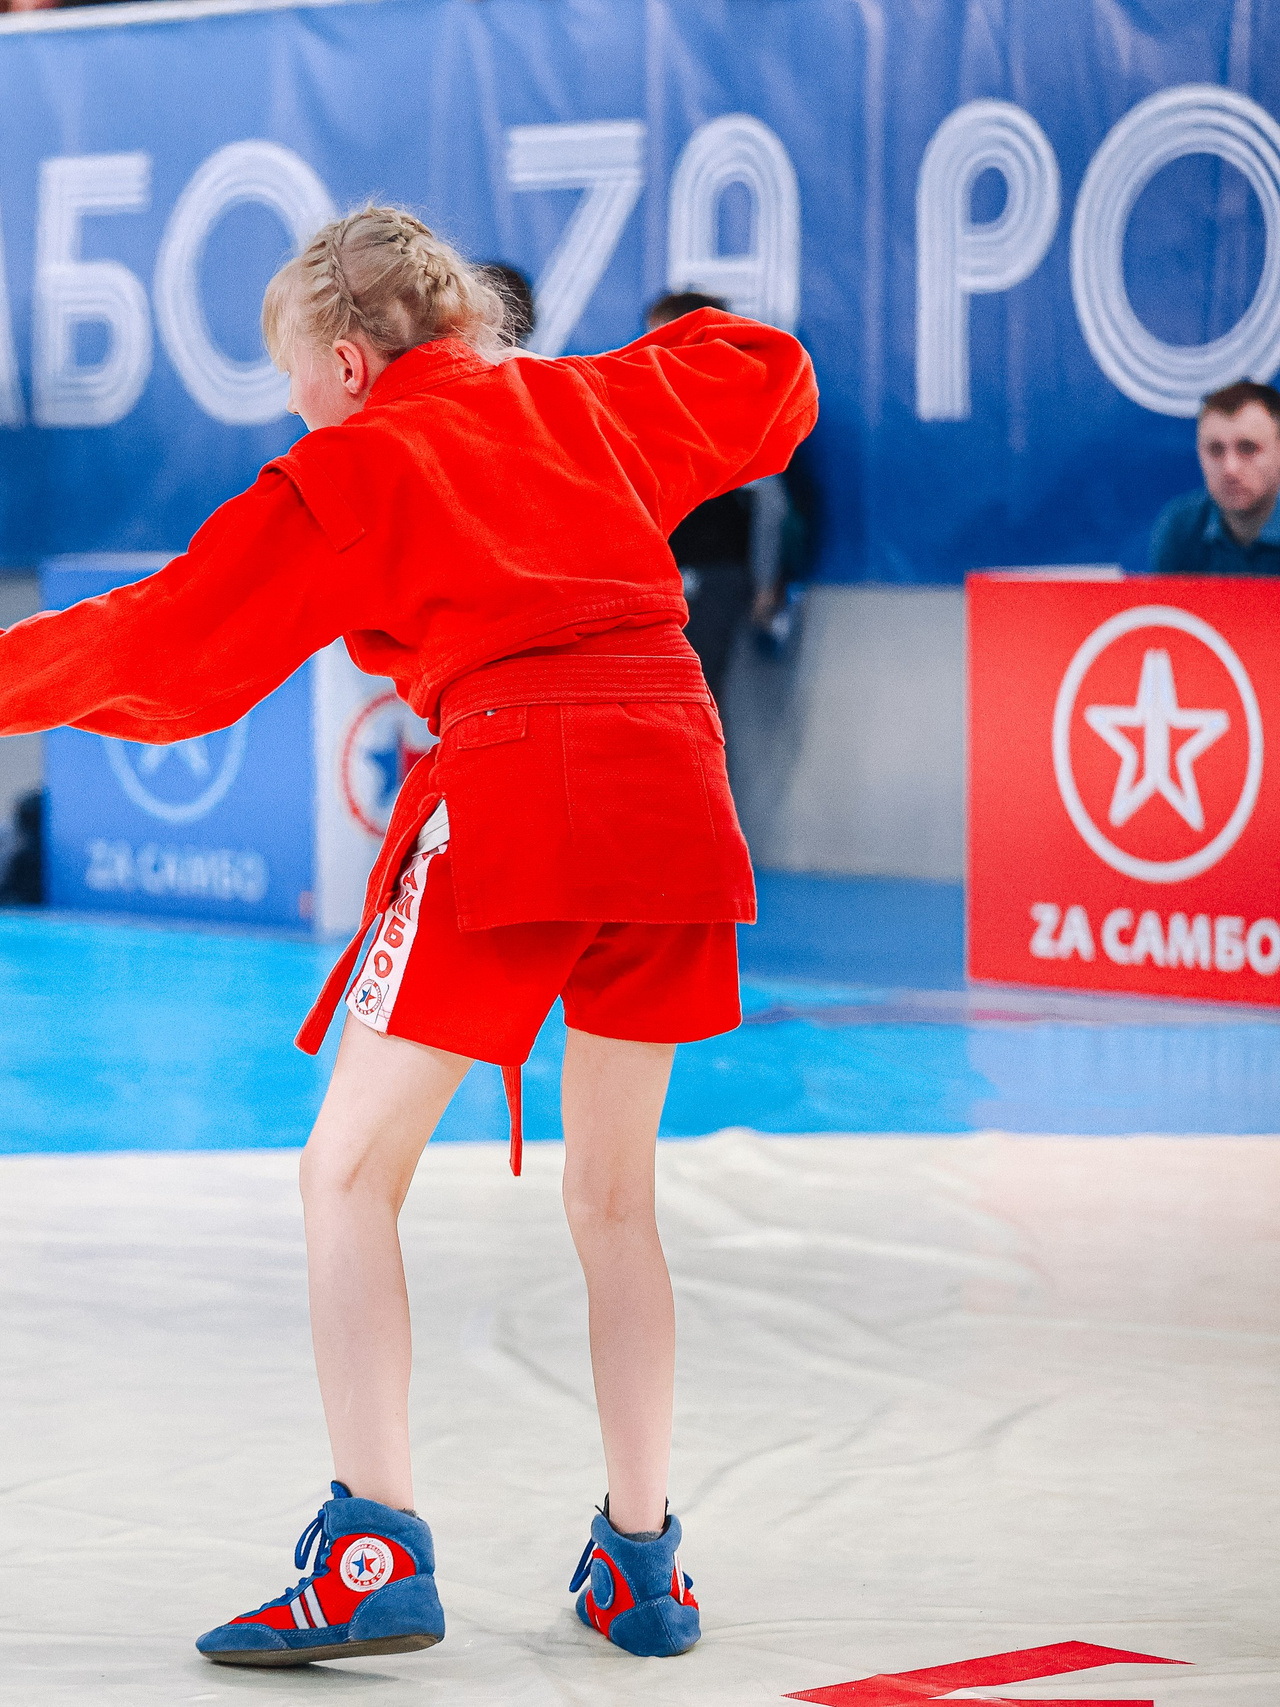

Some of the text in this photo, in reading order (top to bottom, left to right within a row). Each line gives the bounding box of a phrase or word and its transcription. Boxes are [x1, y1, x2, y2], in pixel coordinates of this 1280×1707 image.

[373, 847, 435, 978] АМБО
[1030, 902, 1280, 976] ZA САМБО
